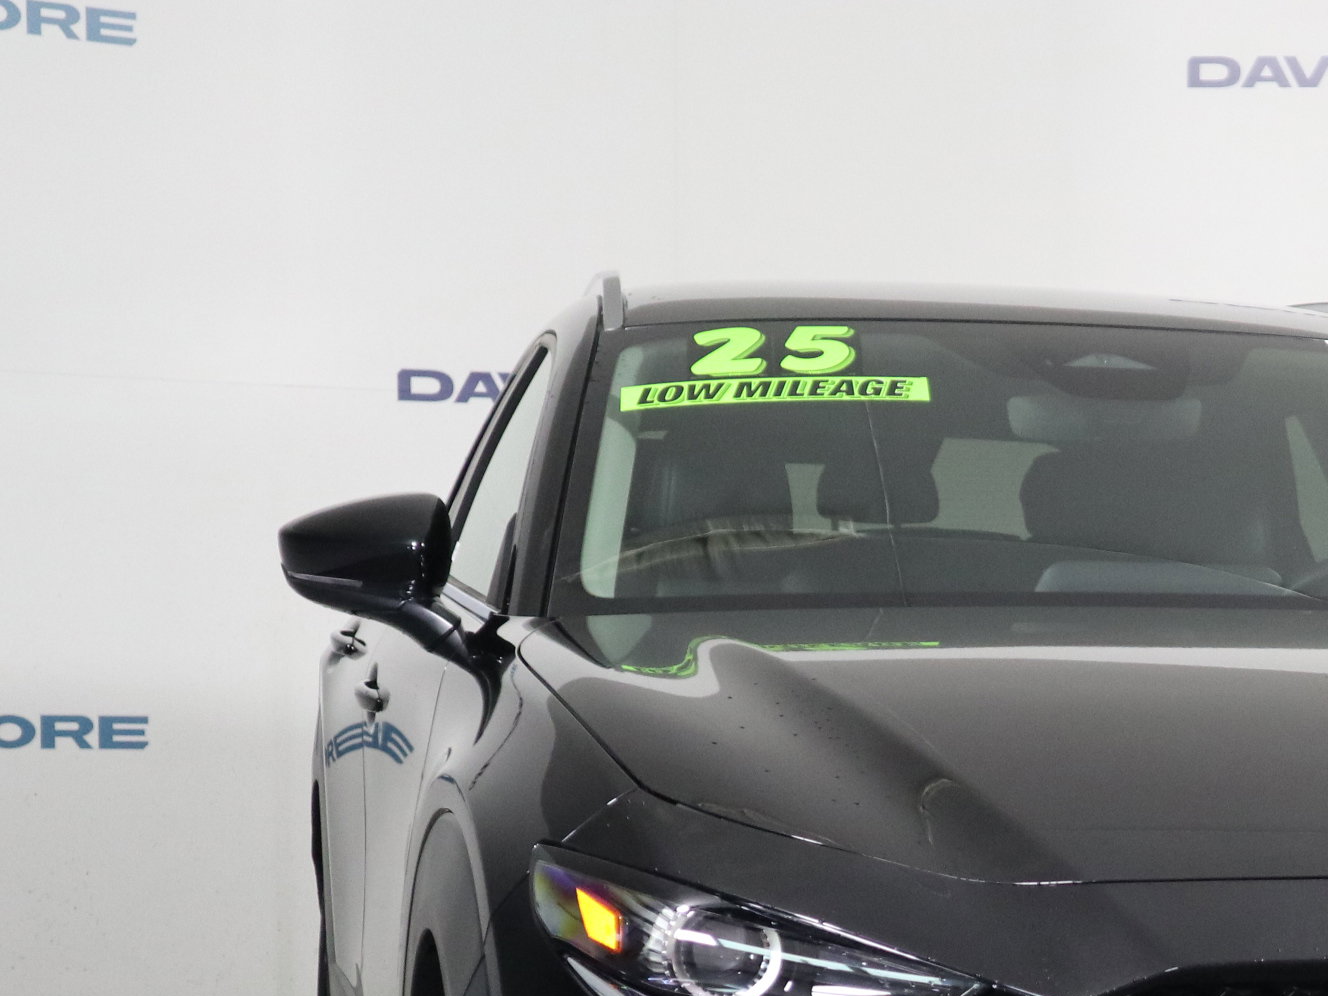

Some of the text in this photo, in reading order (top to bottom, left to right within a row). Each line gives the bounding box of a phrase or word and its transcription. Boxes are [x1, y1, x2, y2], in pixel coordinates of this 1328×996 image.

[690, 326, 856, 376] 25
[398, 369, 516, 403] DA
[637, 378, 913, 406] LOW MILEAGE
